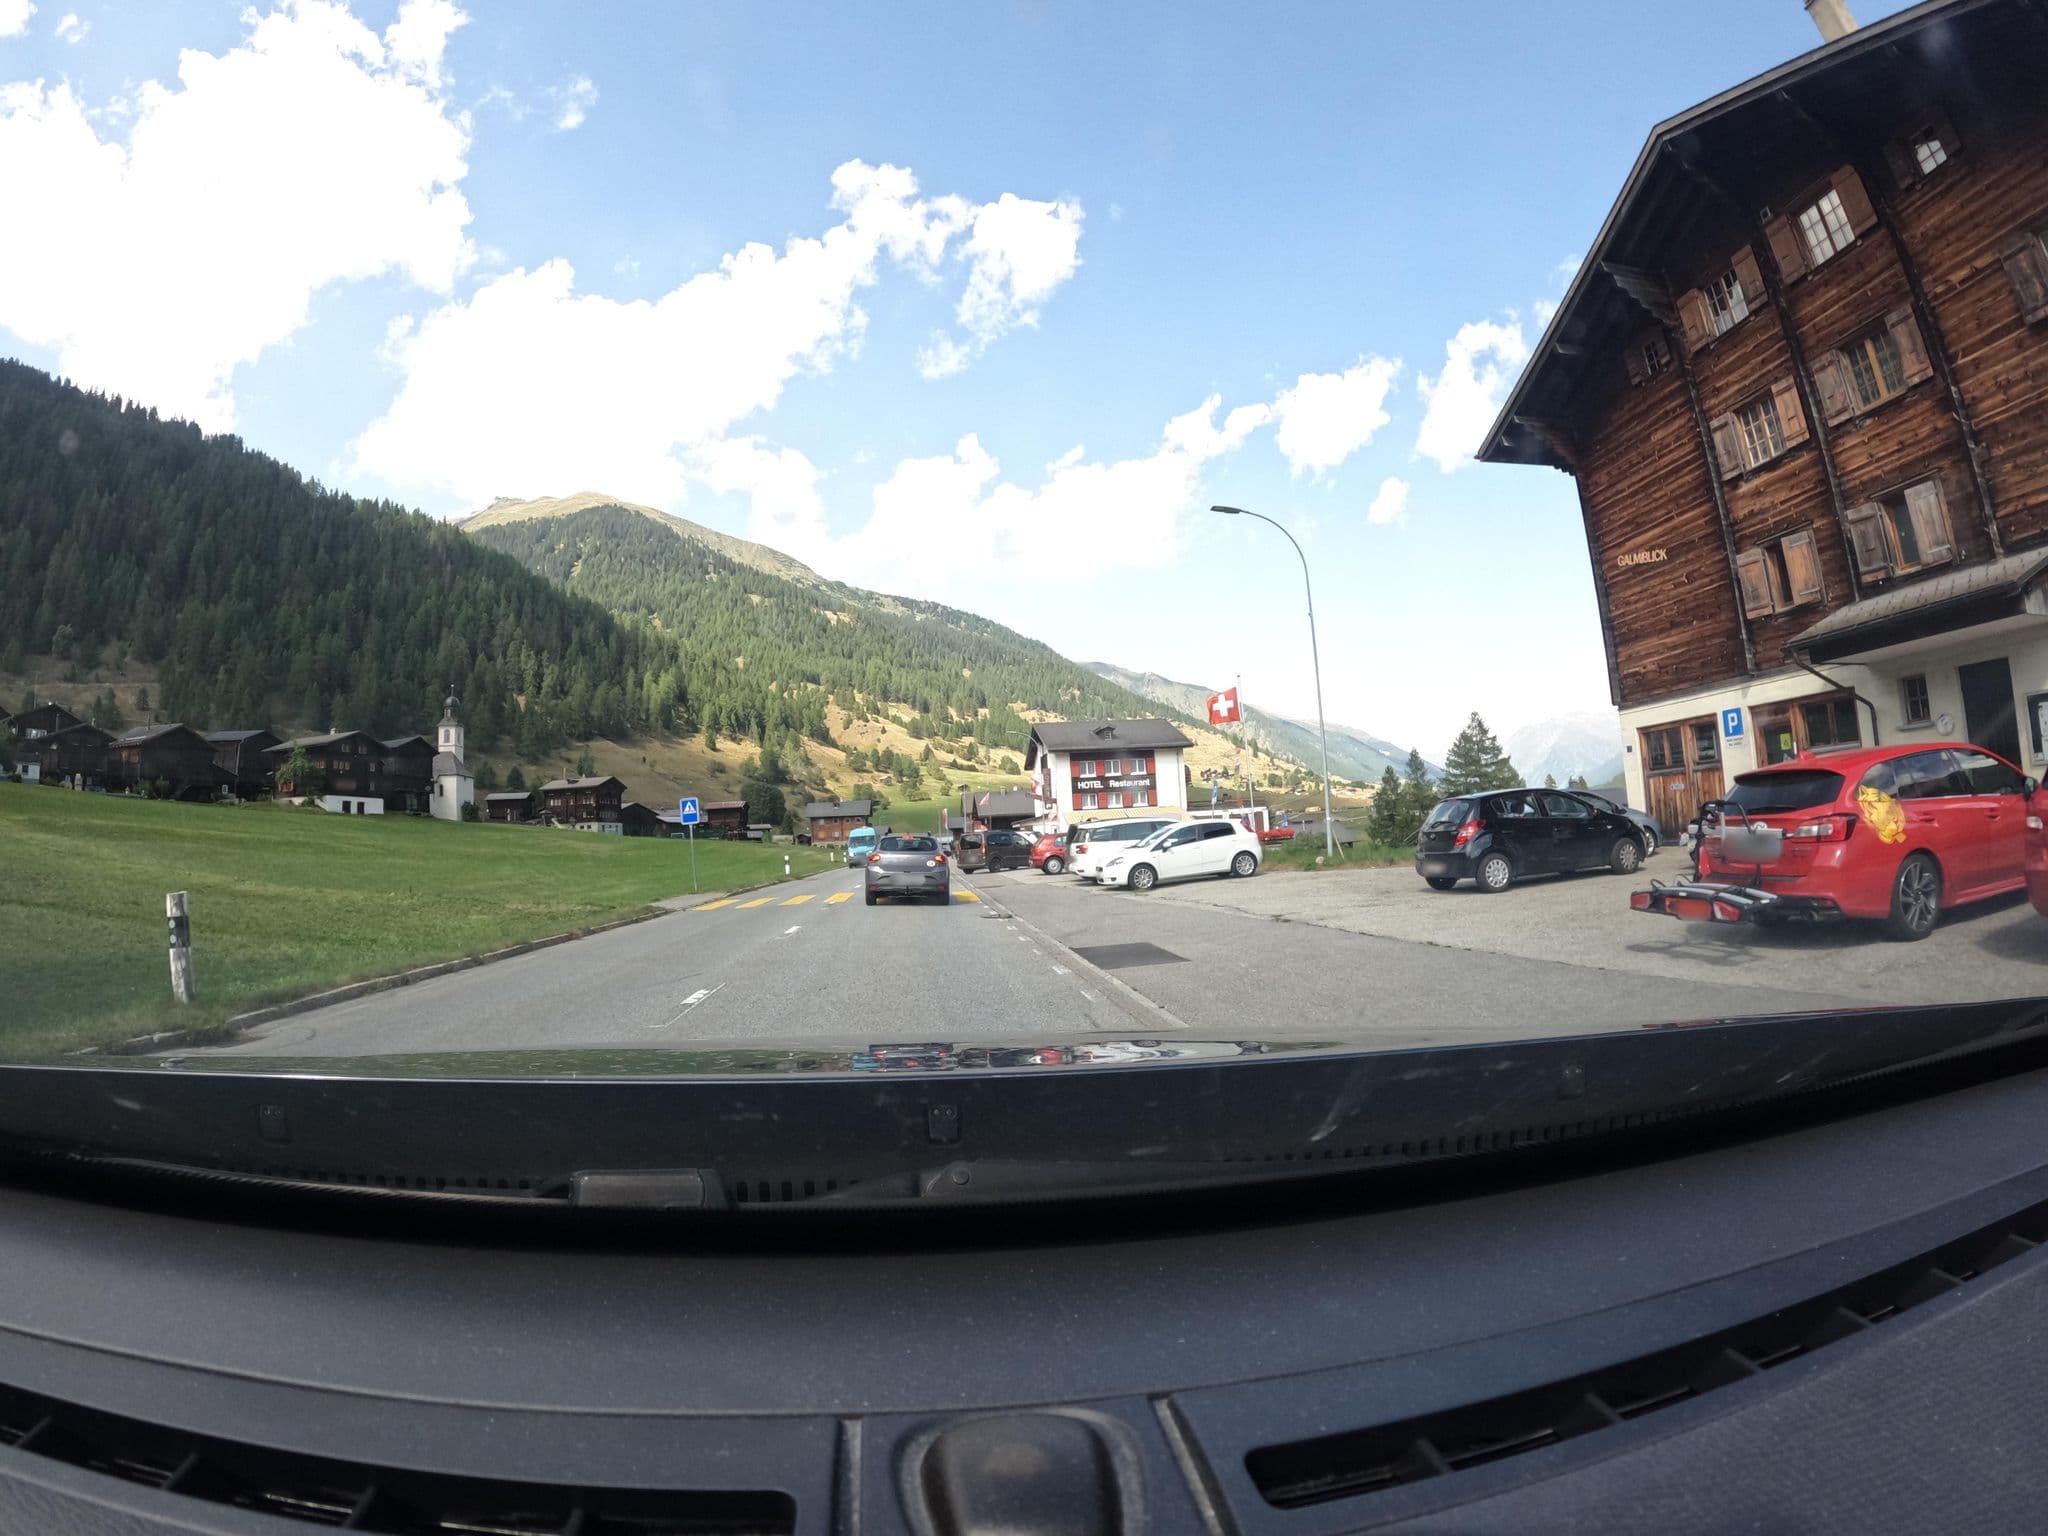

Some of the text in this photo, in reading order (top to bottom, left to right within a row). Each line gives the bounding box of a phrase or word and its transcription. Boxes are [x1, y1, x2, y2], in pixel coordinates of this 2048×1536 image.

[1727, 712, 1739, 734] P
[1077, 778, 1151, 790] HOTEL Restaurant
